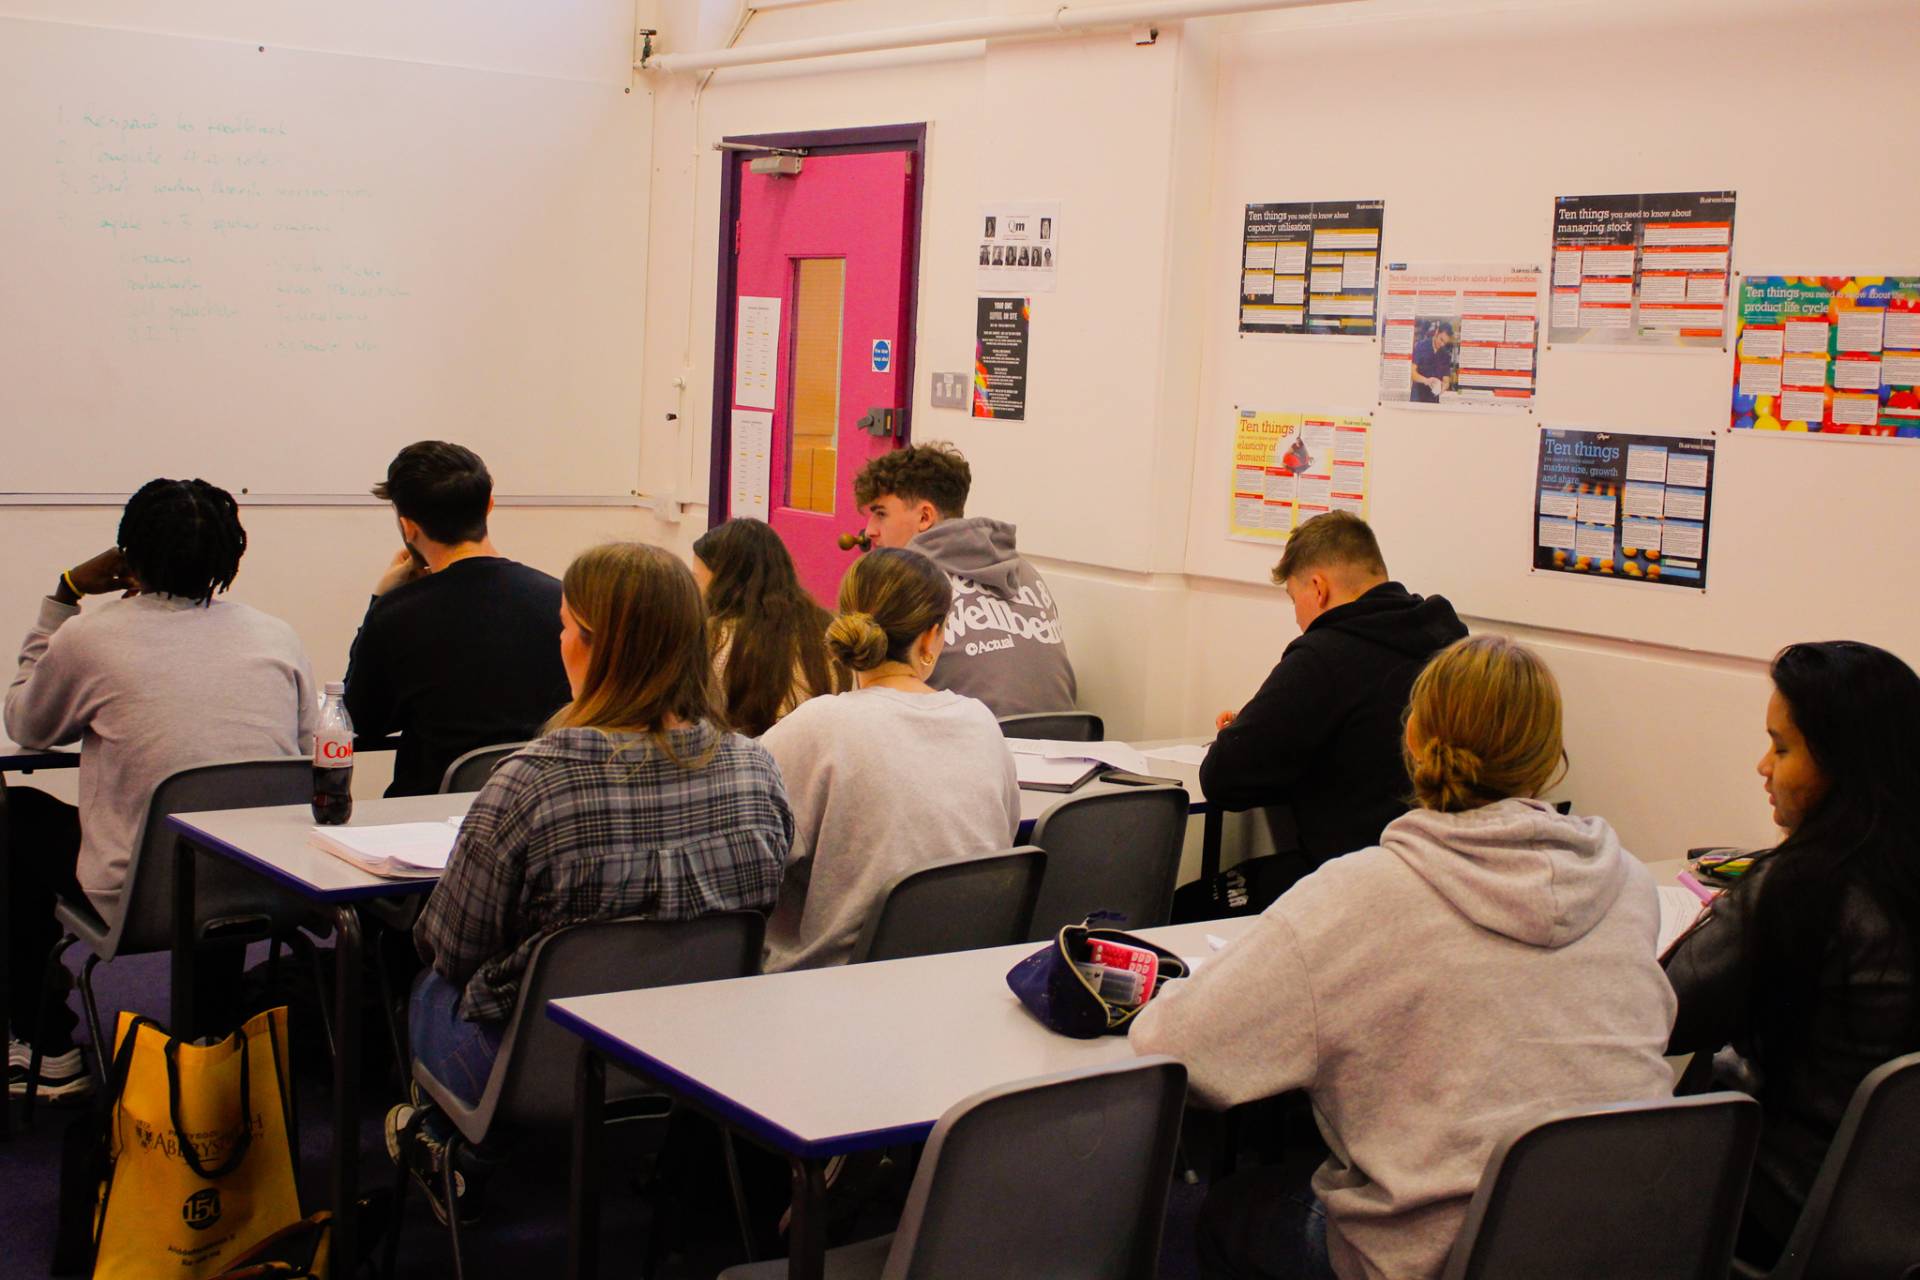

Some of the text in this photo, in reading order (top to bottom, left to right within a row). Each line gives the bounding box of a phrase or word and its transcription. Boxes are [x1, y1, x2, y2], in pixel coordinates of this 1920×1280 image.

[1248, 211, 1262, 221] Ten
[1264, 210, 1288, 222] things
[1298, 212, 1312, 220] need
[1334, 211, 1350, 219] about
[1558, 208, 1692, 222] Ten things you need to know about
[1247, 222, 1311, 234] capacity utilisation
[1558, 222, 1632, 235] managing stock
[1745, 286, 1764, 298] Ten
[1766, 286, 1799, 300] things
[1800, 292, 1814, 300] you
[1815, 290, 1836, 299] need
[1868, 288, 1890, 299] about
[1744, 302, 1829, 315] product life cycle
[1240, 420, 1294, 438] Ten things
[1269, 442, 1277, 451] of
[1545, 438, 1620, 462] Ten things
[1236, 452, 1265, 462] demand
[1544, 464, 1570, 472] market
[1590, 467, 1618, 478] growth
[1542, 474, 1580, 484] and share
